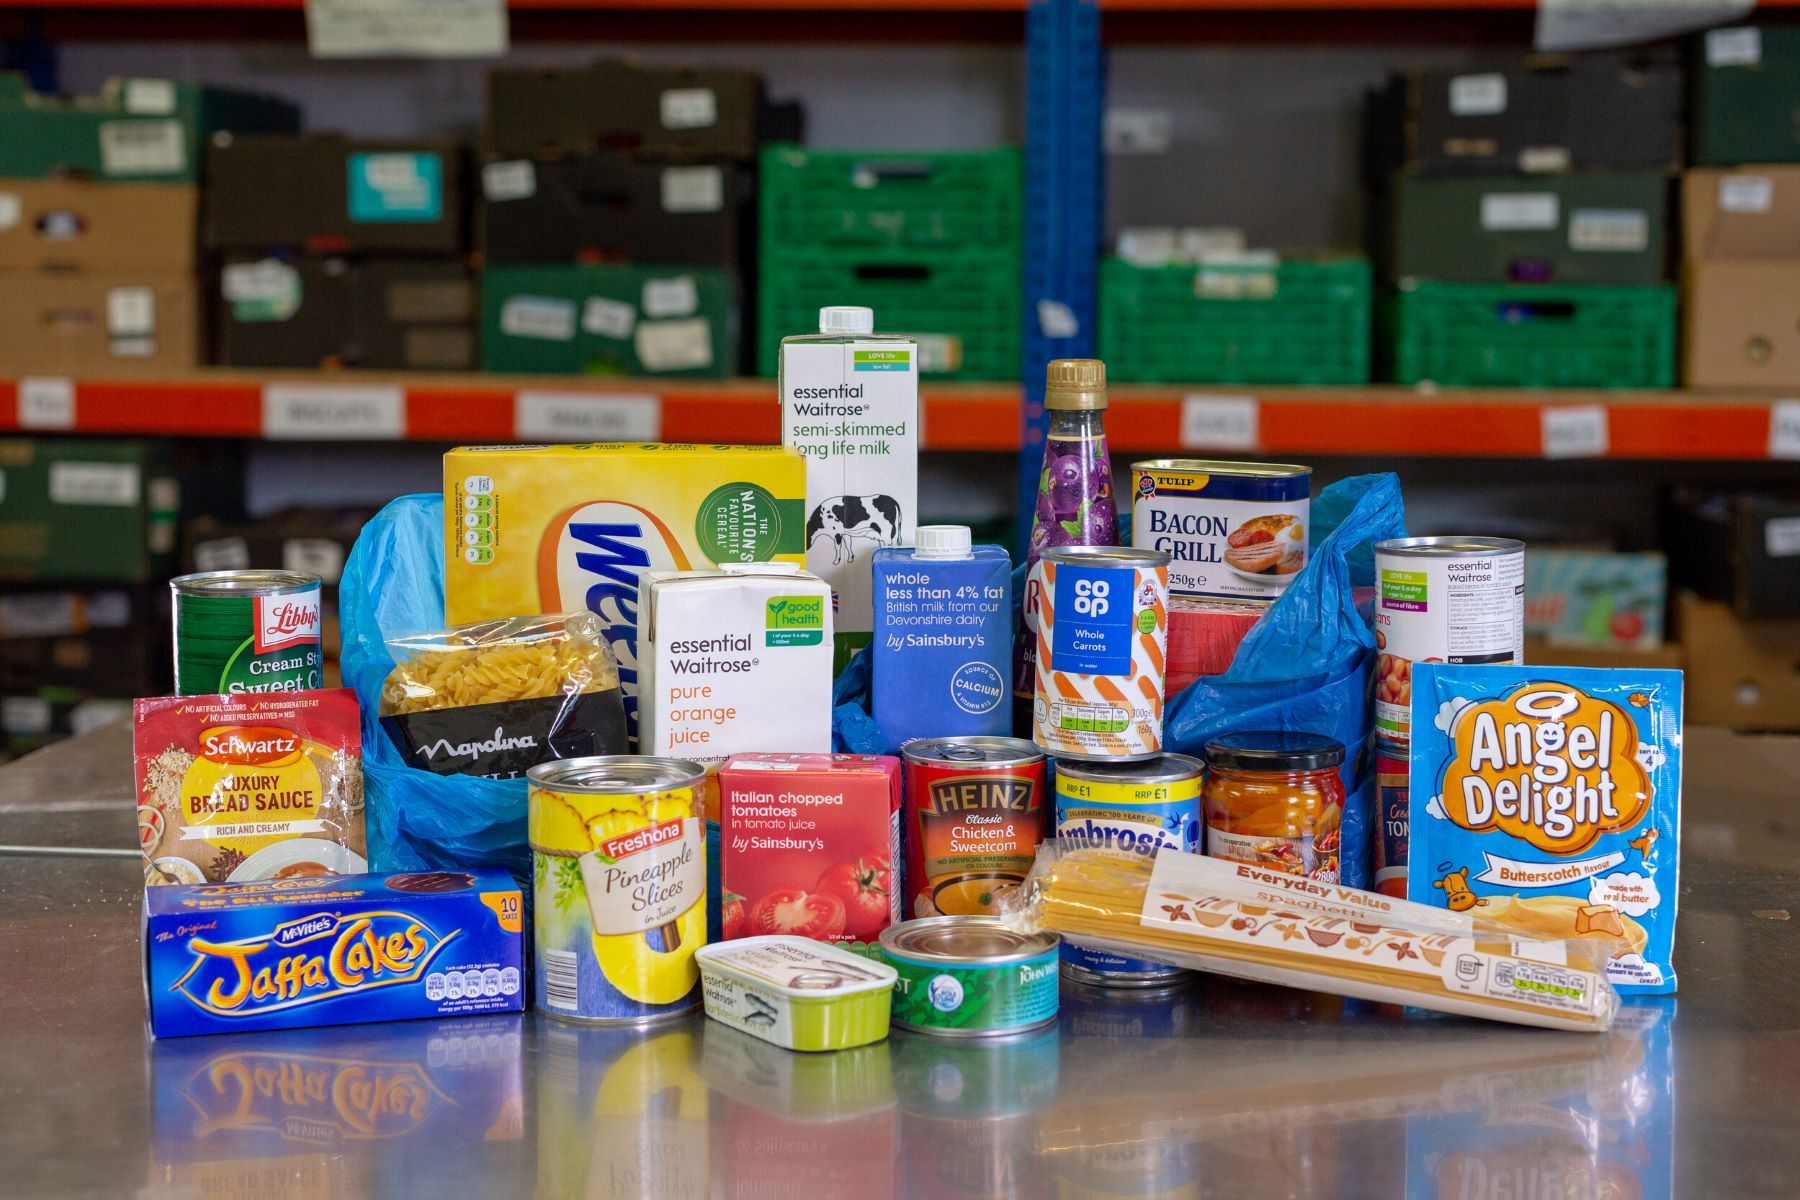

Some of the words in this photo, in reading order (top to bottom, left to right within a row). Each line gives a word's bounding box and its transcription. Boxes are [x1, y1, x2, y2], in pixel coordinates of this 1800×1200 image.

[793, 383, 864, 399] essential
[793, 403, 863, 416] Waitrose
[793, 421, 906, 437] semi-skimmed
[833, 440, 856, 455] life
[860, 440, 891, 455] milk
[1157, 476, 1195, 486] TULIP
[729, 498, 739, 554] FAVOURITE
[740, 490, 758, 563] NATION'S
[759, 517, 768, 536] THE
[1149, 509, 1229, 537] BACON
[1154, 536, 1222, 563] GRILL
[1447, 559, 1492, 571] essential
[886, 572, 930, 585] whole
[1447, 572, 1492, 583] Waitrose
[886, 586, 912, 599] less
[917, 586, 951, 599] than
[956, 586, 979, 599] 4%
[983, 586, 1005, 599] fat
[788, 600, 819, 613] good
[886, 601, 918, 612] British
[921, 601, 945, 612] milk
[948, 601, 976, 612] from
[979, 603, 999, 612] our
[1406, 602, 1419, 610] fibre
[782, 613, 819, 625] health
[886, 614, 952, 626] Devonshire
[955, 614, 986, 627] dairy
[1075, 628, 1105, 640] Whole
[670, 633, 752, 654] essential
[886, 633, 904, 652] by
[906, 633, 985, 649] Sainsbury's
[1072, 640, 1107, 652] Carrots
[250, 657, 303, 675] Cream
[670, 657, 751, 676] Waitrose
[964, 666, 989, 675] SOURCE
[670, 685, 712, 704] pure
[955, 678, 1000, 697] CALCIUM
[185, 705, 194, 713] NO
[195, 704, 222, 713] ARTIFICIAL
[223, 703, 247, 712] COLOURS
[260, 701, 269, 710] NO
[269, 700, 308, 709] HYDROGENATED
[308, 699, 319, 708] FAT
[210, 714, 219, 722] NO
[220, 713, 236, 722] ADDED
[236, 711, 278, 721] PRESERVATIVES
[284, 711, 295, 719] MSG
[670, 708, 737, 724] orange
[204, 735, 295, 757] Schwartz
[416, 726, 538, 760] Napolina
[669, 727, 711, 750] juice
[1470, 710, 1613, 785] Angel
[1645, 755, 1653, 766] 4
[221, 775, 280, 792] LUXURY
[1066, 783, 1079, 792] RRP
[1079, 785, 1091, 797] £1
[731, 791, 775, 804] Italian
[778, 793, 844, 806] chopped
[938, 784, 1028, 813] HEINZ
[1135, 790, 1152, 799] RRP
[1154, 788, 1168, 799] £1
[190, 795, 250, 814] BREAD
[255, 790, 314, 811] SAUCE
[1461, 769, 1619, 839] Delight
[731, 805, 797, 818] tomatoes
[965, 813, 1003, 825] Classic
[1068, 810, 1107, 818] CELEBRATING
[1108, 811, 1121, 819] 100
[1123, 813, 1146, 822] YEARS
[1147, 816, 1157, 824] OF
[216, 825, 236, 836] RICH
[239, 824, 255, 834] AND
[256, 822, 290, 833] CREAMY
[731, 818, 742, 829] in
[744, 818, 786, 829] tomato
[788, 818, 816, 831] juice
[951, 825, 1005, 839] Chicken
[1006, 824, 1016, 838] &
[608, 823, 680, 858] Freshona
[731, 834, 749, 853] by
[751, 836, 824, 852] Sainsbury's
[950, 839, 1017, 853] Sweetcorn
[604, 841, 693, 894] Pineapple
[948, 856, 982, 864] ARTIFICIAL
[1500, 865, 1581, 882] Butterscotch
[1583, 860, 1611, 874] flavour
[631, 880, 684, 912] Slices
[1236, 864, 1332, 898] Everyday
[1336, 887, 1392, 912] Value
[1629, 884, 1643, 893] with
[500, 897, 517, 913] 10
[1256, 890, 1366, 920] spaghetti
[1621, 893, 1650, 904] butter
[502, 913, 518, 921] CAKES
[656, 904, 677, 920] Juice
[156, 930, 175, 943] The
[177, 920, 218, 936] Original
[282, 917, 331, 942] McVitie's
[190, 937, 328, 1010] Jaffa
[329, 918, 428, 987] Cakes
[1019, 969, 1044, 986] JOHN
